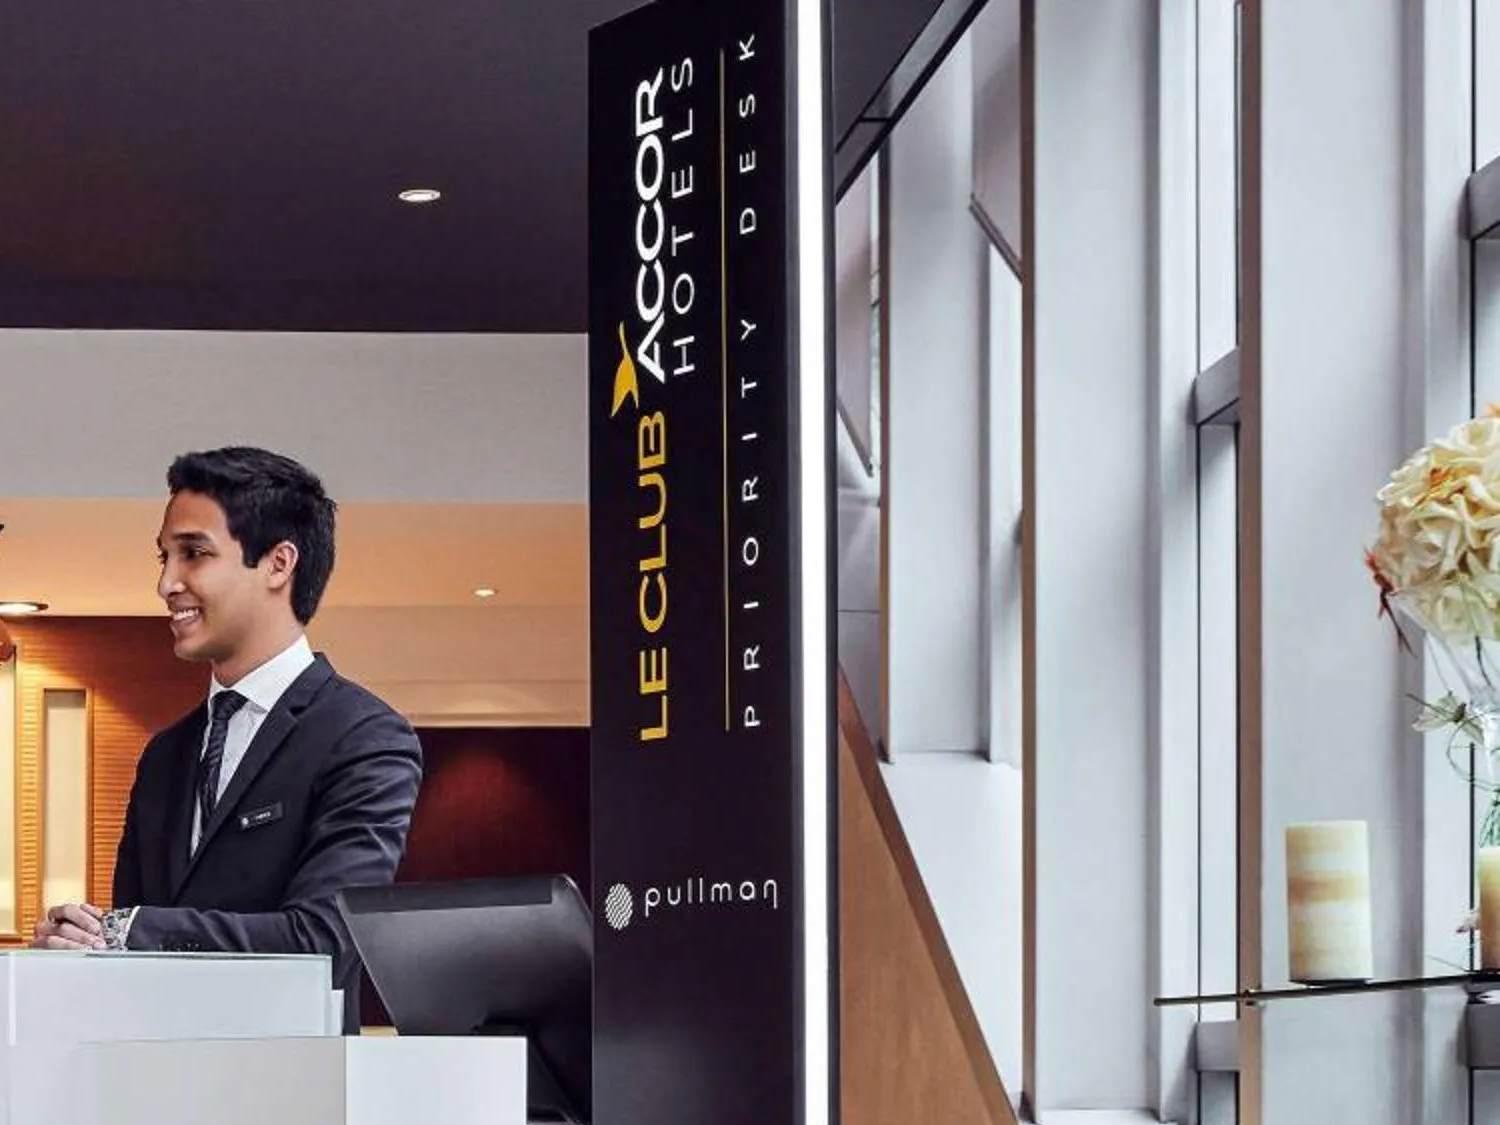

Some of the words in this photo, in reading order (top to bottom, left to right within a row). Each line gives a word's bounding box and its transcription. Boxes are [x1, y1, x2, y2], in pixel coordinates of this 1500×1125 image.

[635, 67, 665, 384] ACCOR
[671, 57, 695, 376] HOTELS
[738, 33, 757, 236] DESK
[637, 410, 667, 634] CLUB
[741, 318, 761, 728] PRIORITY
[639, 647, 668, 741] LE
[644, 876, 778, 919] pullman
